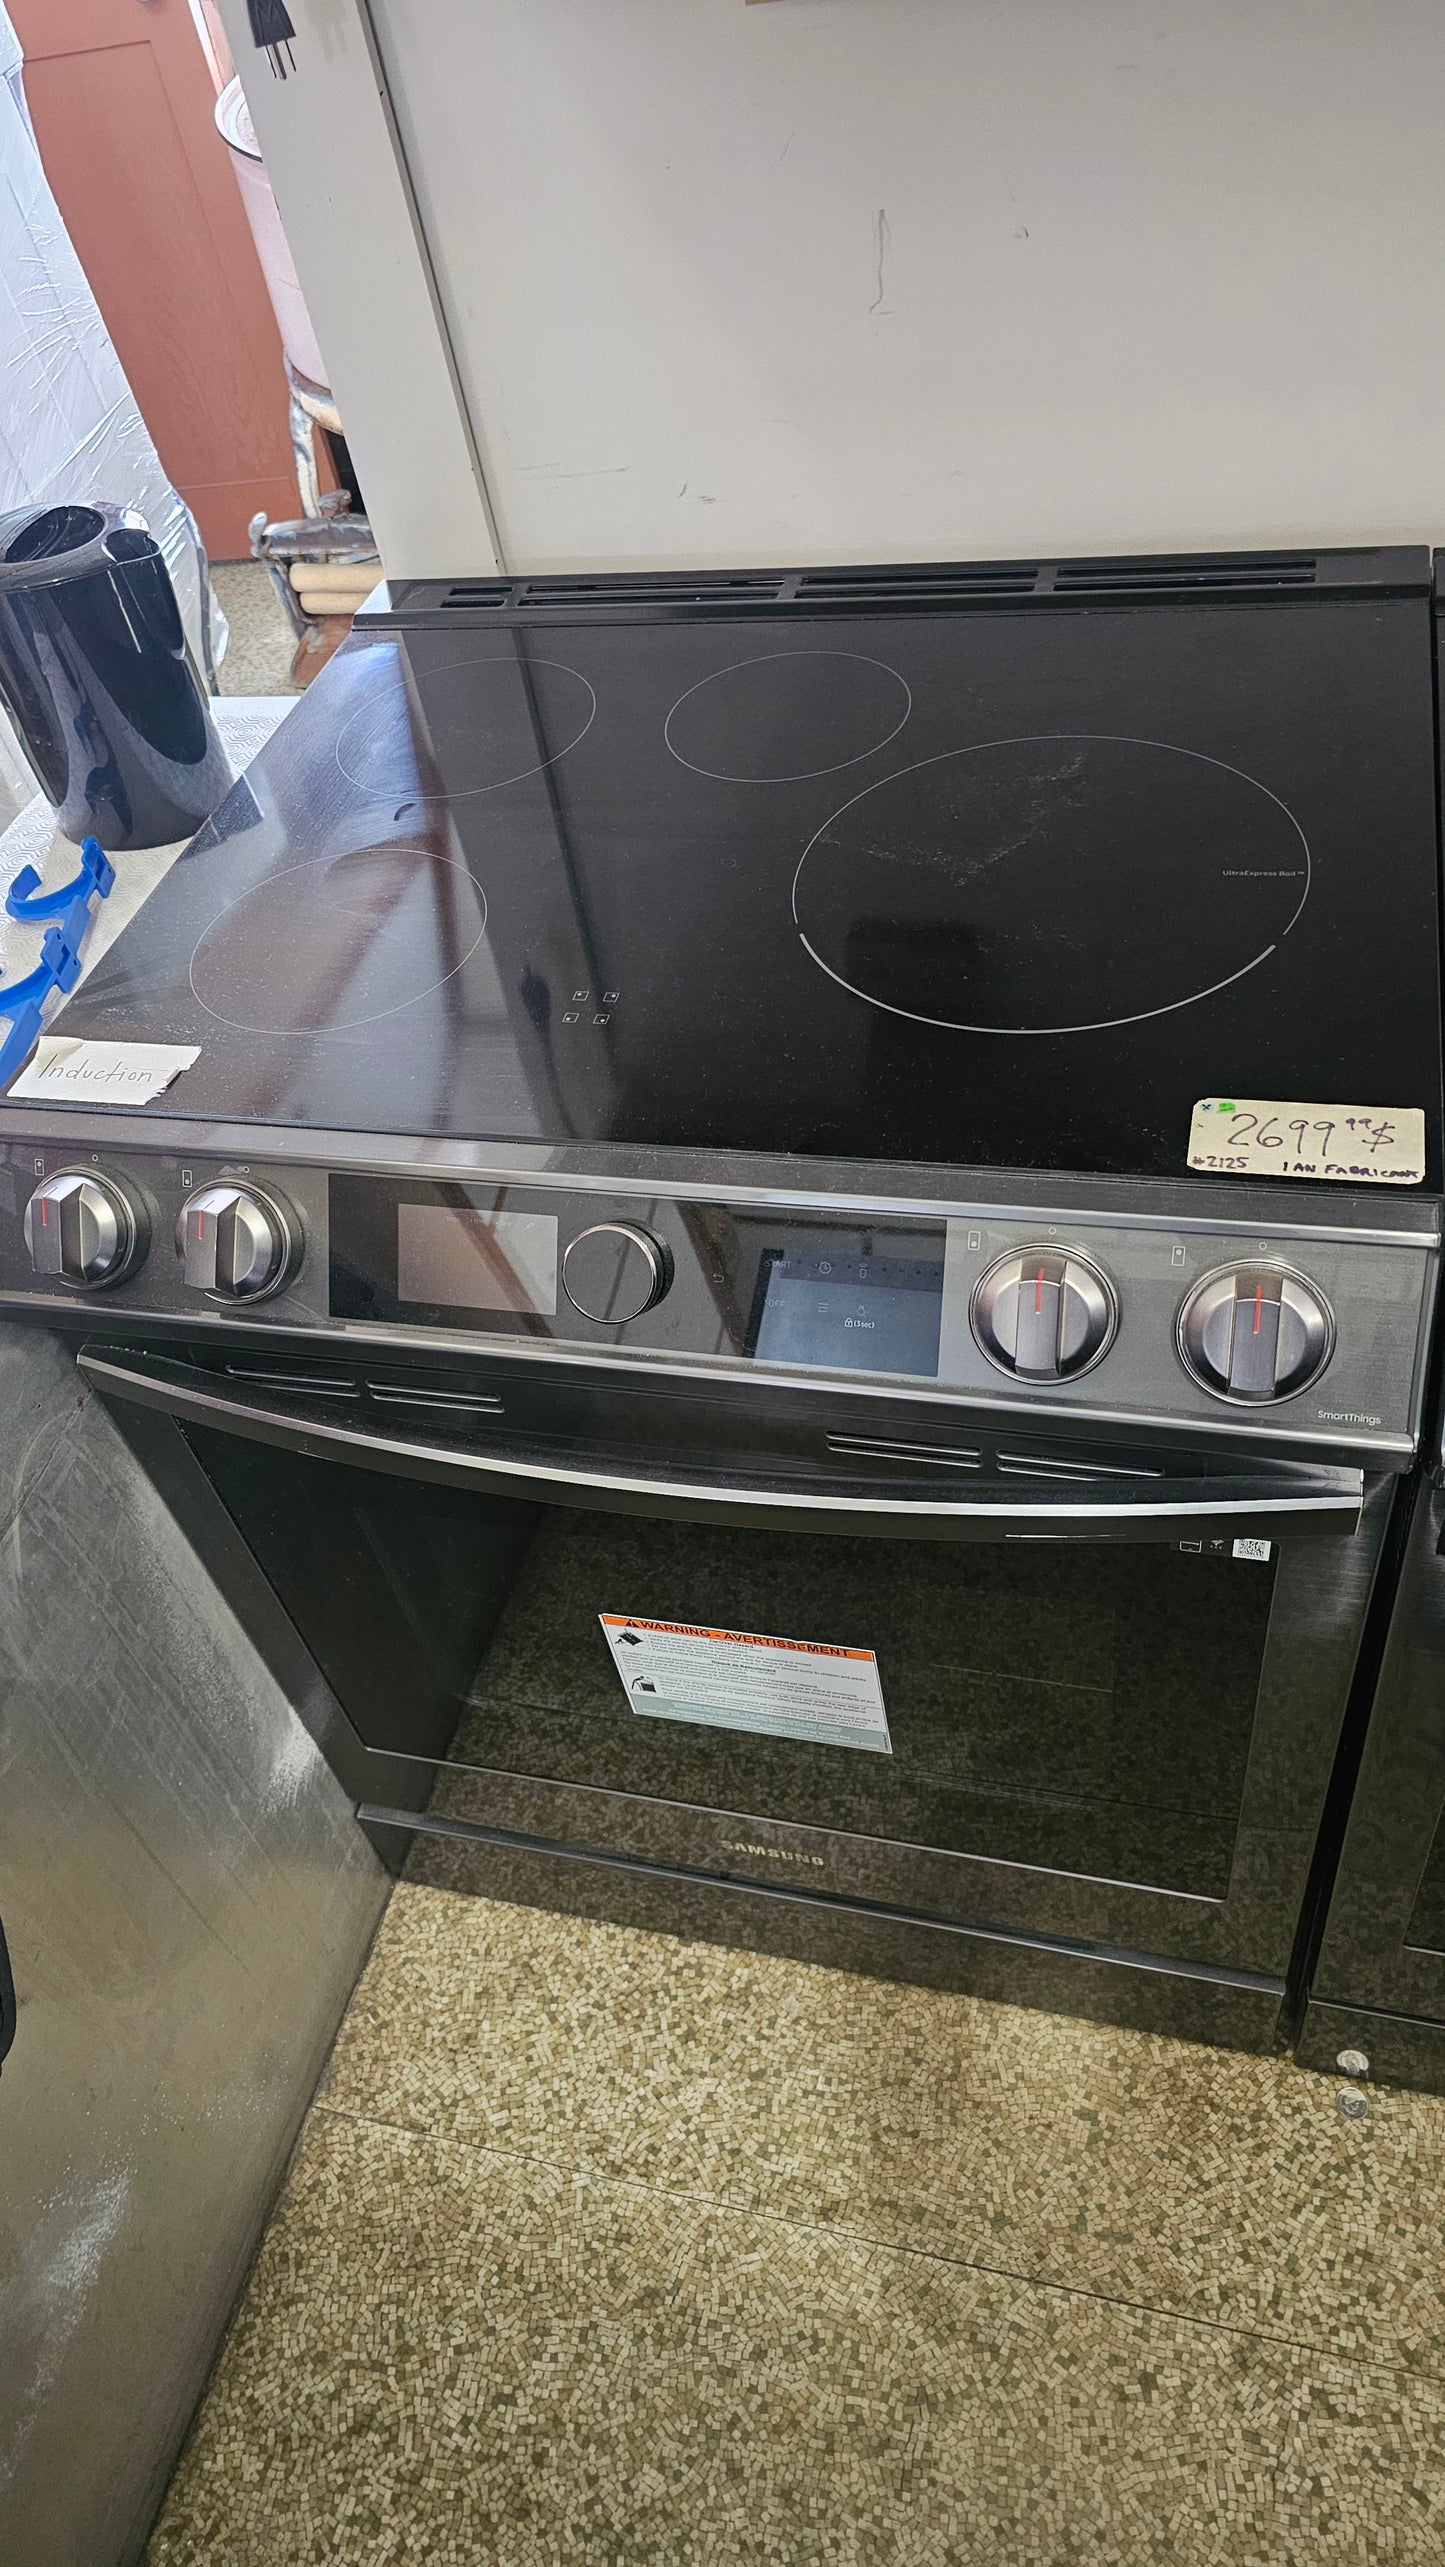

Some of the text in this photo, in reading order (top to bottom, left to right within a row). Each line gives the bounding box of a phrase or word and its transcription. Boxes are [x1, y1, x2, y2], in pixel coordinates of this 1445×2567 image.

[38, 1053, 153, 1084] Induction
[1227, 1113, 1335, 1157] 2699
[1192, 1156, 1250, 1169] #2125
[1293, 1162, 1316, 1173] AN
[1317, 1410, 1382, 1426] SmartThings
[641, 1621, 711, 1637] WARNING
[724, 1633, 848, 1657] AVERTISSEMENT
[720, 1840, 824, 1866] SAMSUNG
